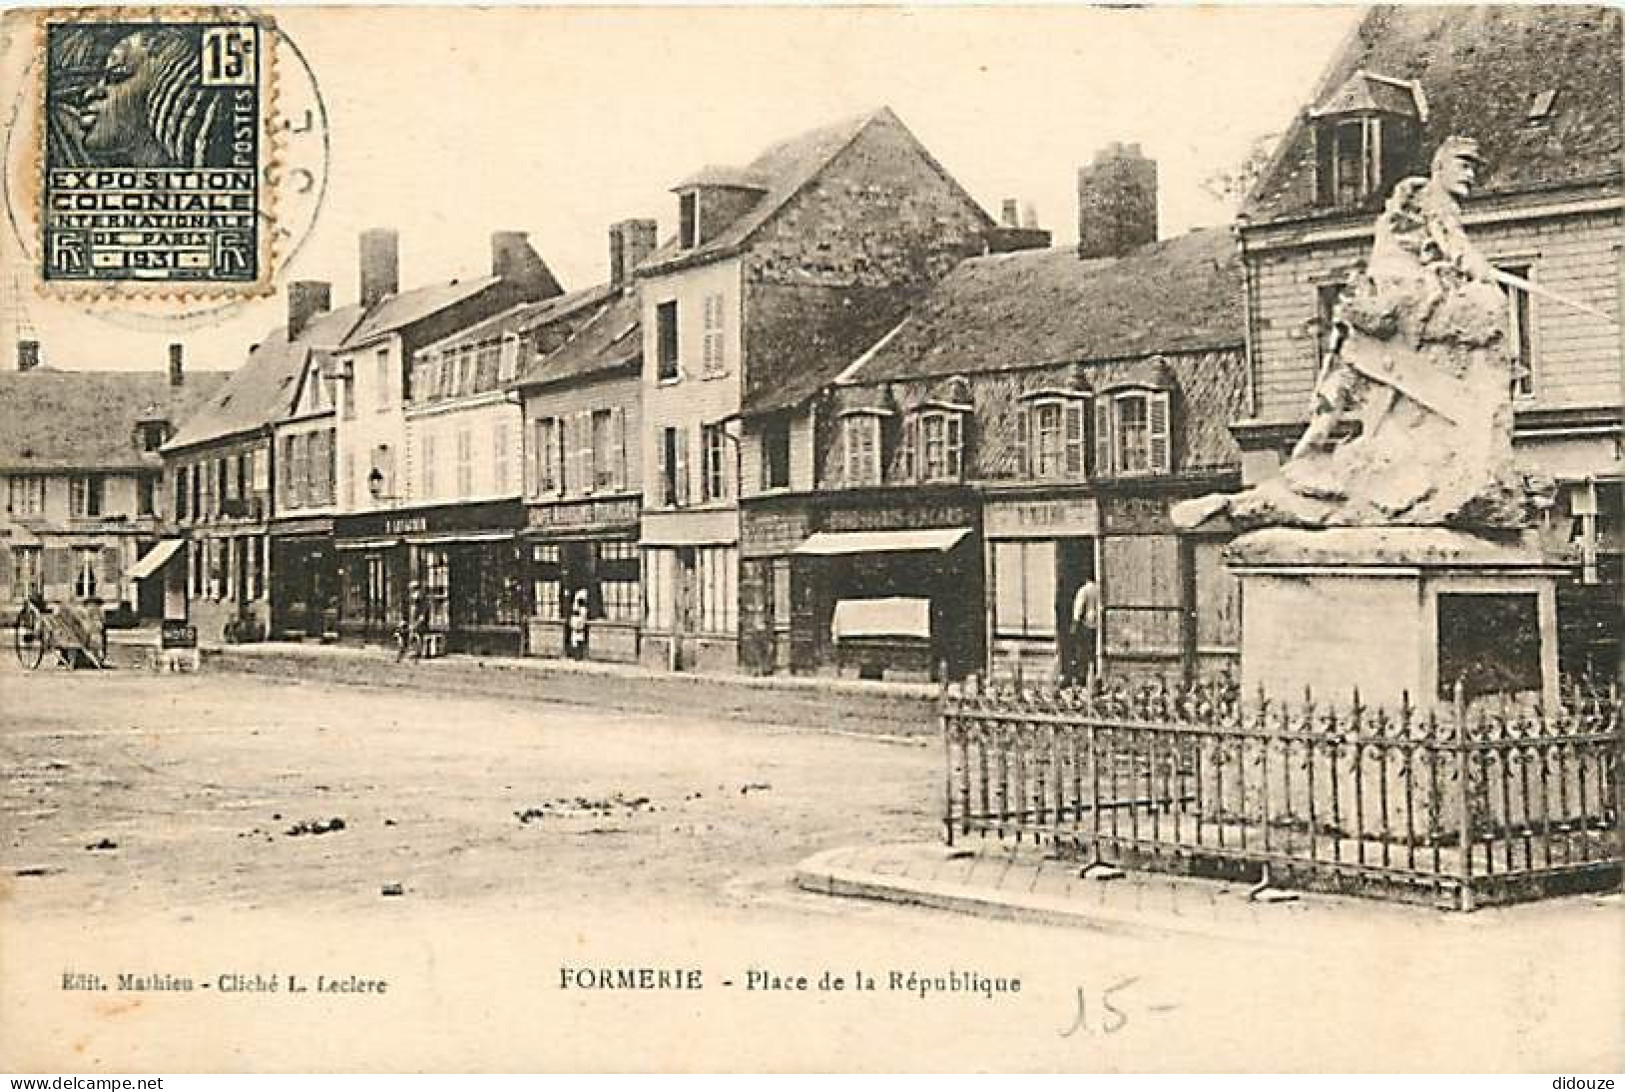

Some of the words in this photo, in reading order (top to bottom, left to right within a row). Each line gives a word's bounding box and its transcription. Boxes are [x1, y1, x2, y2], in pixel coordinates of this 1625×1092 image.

[233, 90, 253, 166] POSTES
[52, 172, 252, 189] EXPOSITION
[53, 194, 252, 210] COLONIALE
[95, 233, 120, 245] DE
[142, 233, 209, 245] PARIS
[117, 973, 193, 991] Mathieu
[218, 973, 279, 993] Cliché
[560, 968, 703, 989] FORMERIE
[746, 969, 808, 991] Place
[818, 970, 845, 991] de
[856, 970, 875, 991] la
[889, 970, 1022, 999] République
